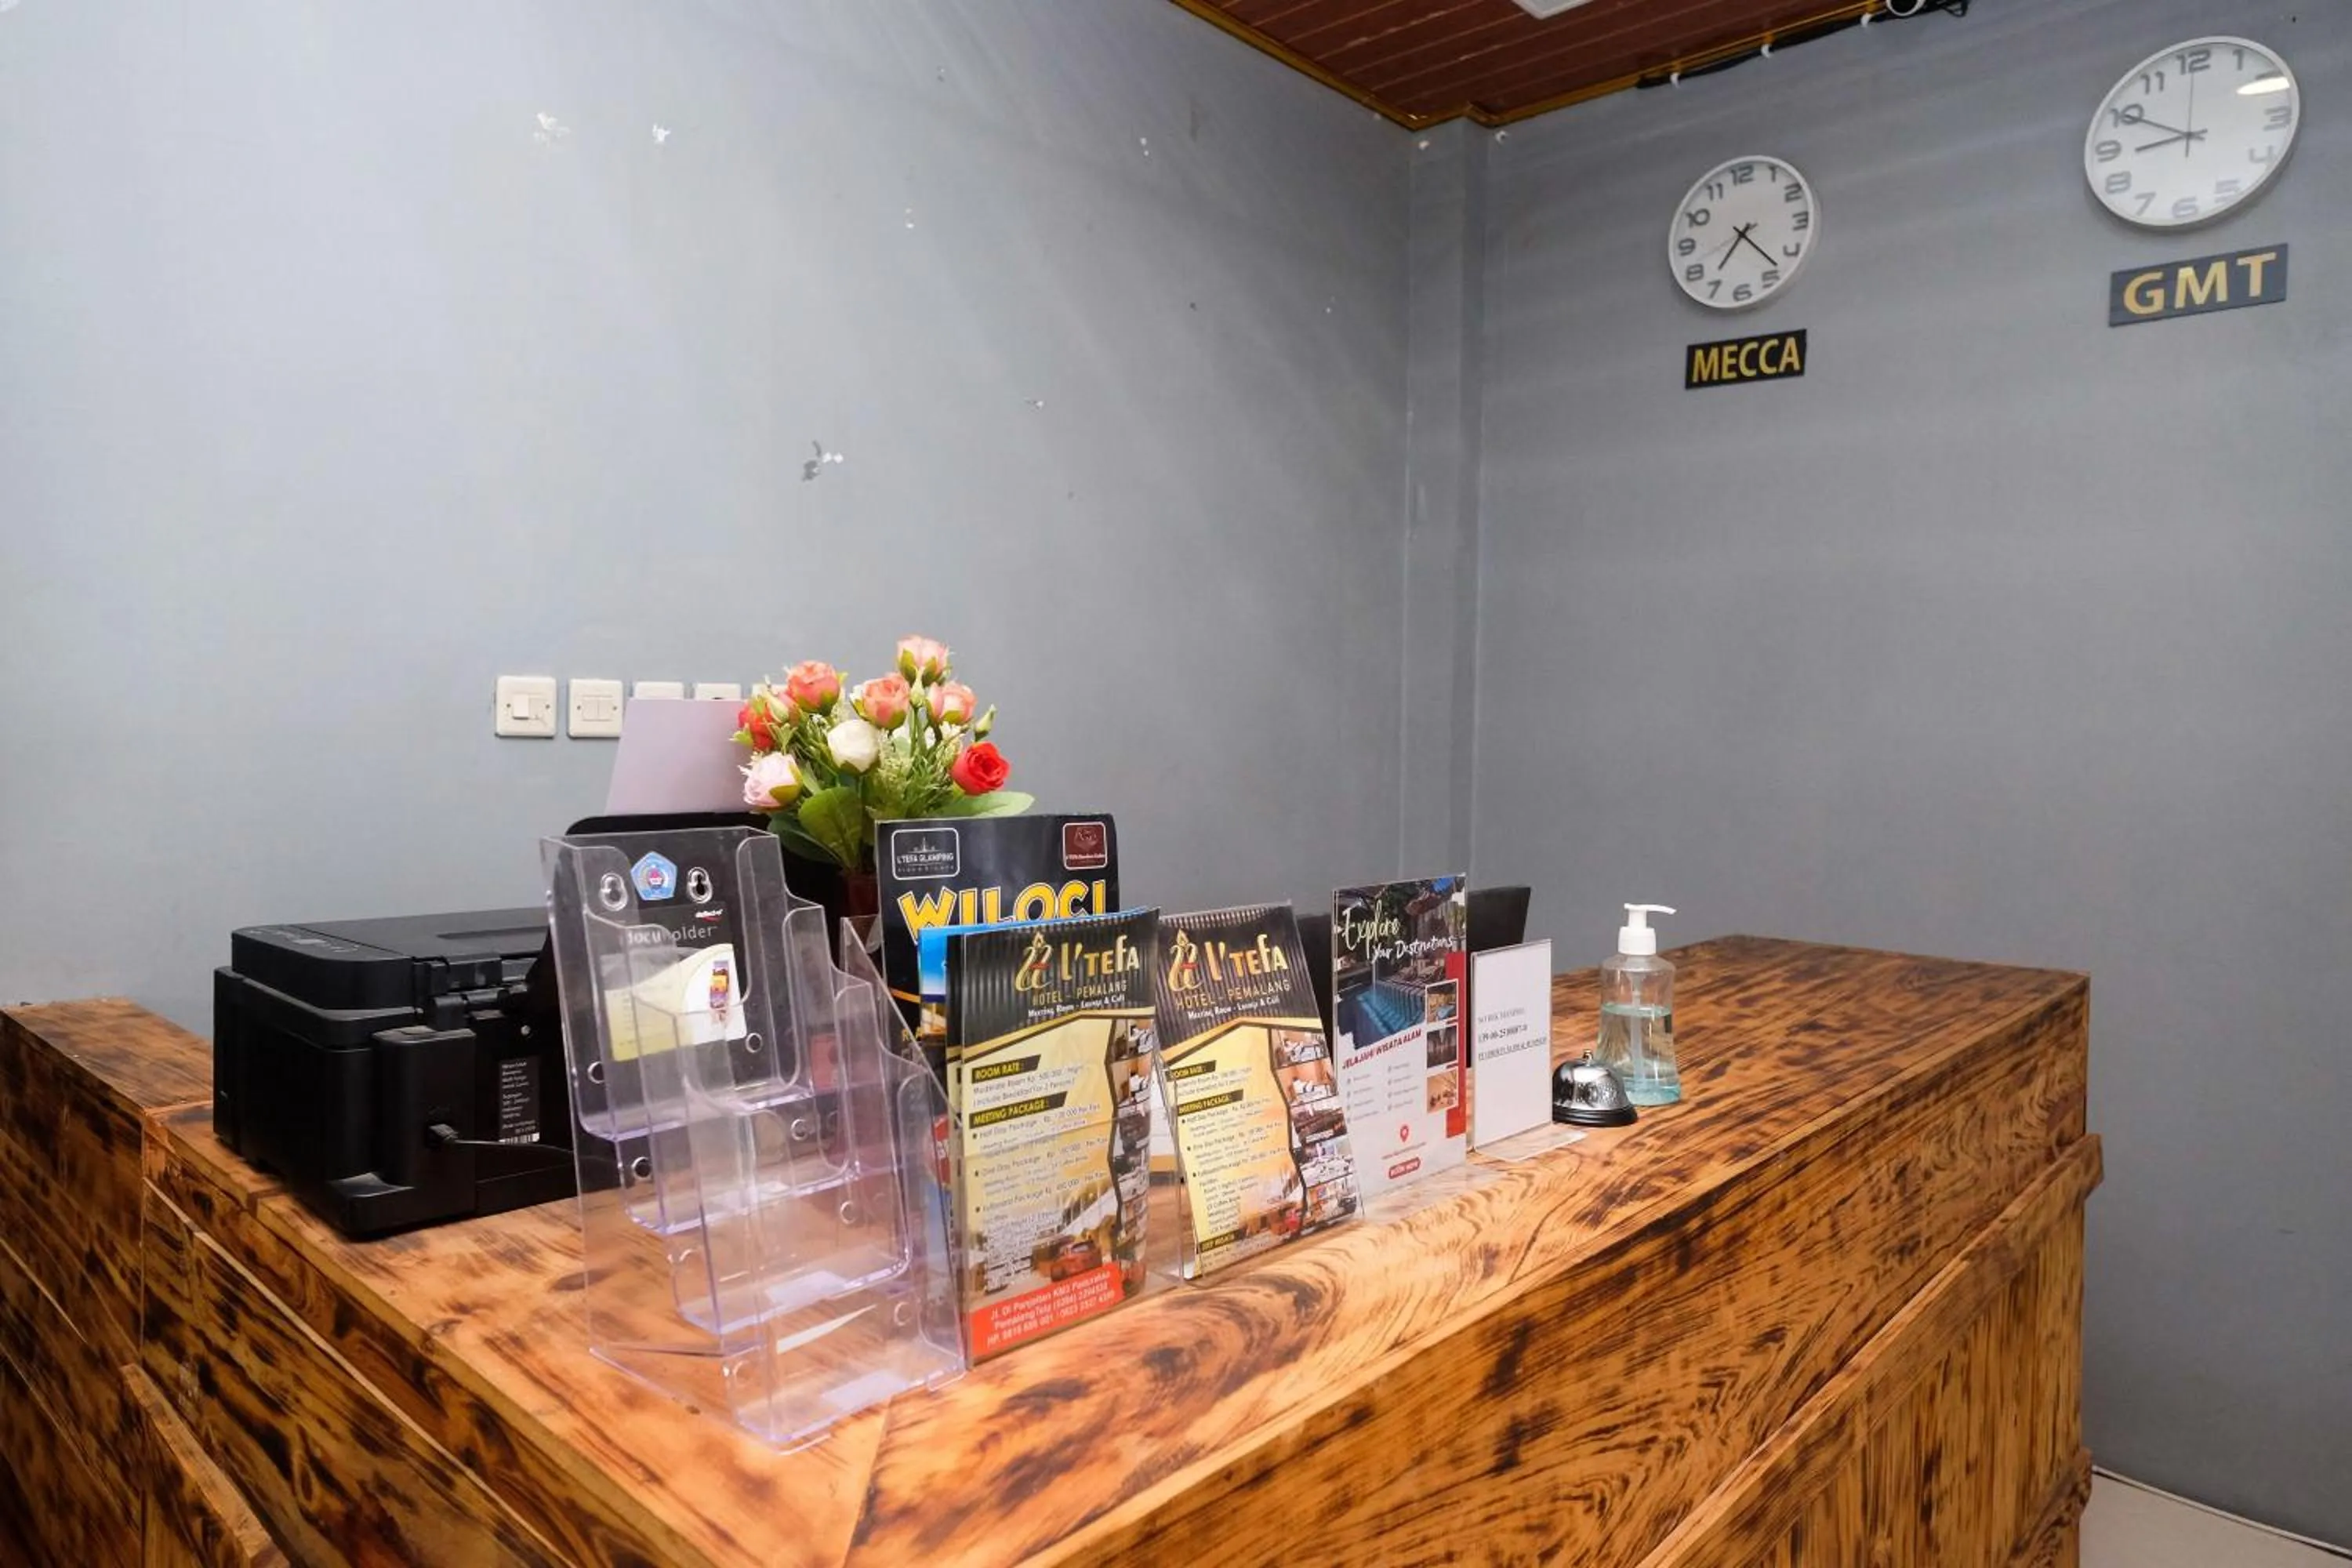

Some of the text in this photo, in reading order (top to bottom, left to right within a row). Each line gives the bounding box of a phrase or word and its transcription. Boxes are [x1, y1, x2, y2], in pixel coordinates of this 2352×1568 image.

[2176, 49, 2211, 75] 12
[2233, 49, 2245, 71] 1
[2140, 71, 2165, 94] 11
[2110, 103, 2144, 128] 10
[2263, 105, 2291, 132] 3
[2095, 140, 2122, 162] 9
[2249, 144, 2278, 163] 4
[1730, 165, 1754, 186] 12
[1767, 166, 1777, 182] 1
[2105, 171, 2131, 194] 8
[1707, 183, 1723, 200] 11
[1784, 183, 1802, 202] 2
[2214, 179, 2241, 204] 5
[2134, 192, 2156, 216] 7
[2172, 197, 2198, 219] 6
[1686, 208, 1710, 227] 10
[1792, 211, 1809, 230] 3
[1678, 238, 1696, 256] 9
[1783, 242, 1800, 257] 4
[1686, 264, 1704, 281] 8
[1762, 270, 1780, 288] 5
[2123, 252, 2277, 314] GMT
[1707, 280, 1722, 299] 7
[1733, 284, 1752, 301] 6
[1692, 336, 1800, 383] MECCA
[1341, 898, 1401, 960] Explore
[1033, 980, 1127, 1006] HOTEL PEMALANG
[1176, 979, 1290, 1010] HOTEL PEMALANG
[1403, 1029, 1421, 1043] ALAM
[975, 1065, 1000, 1080] ROOM
[974, 1108, 1007, 1125] MEETING
